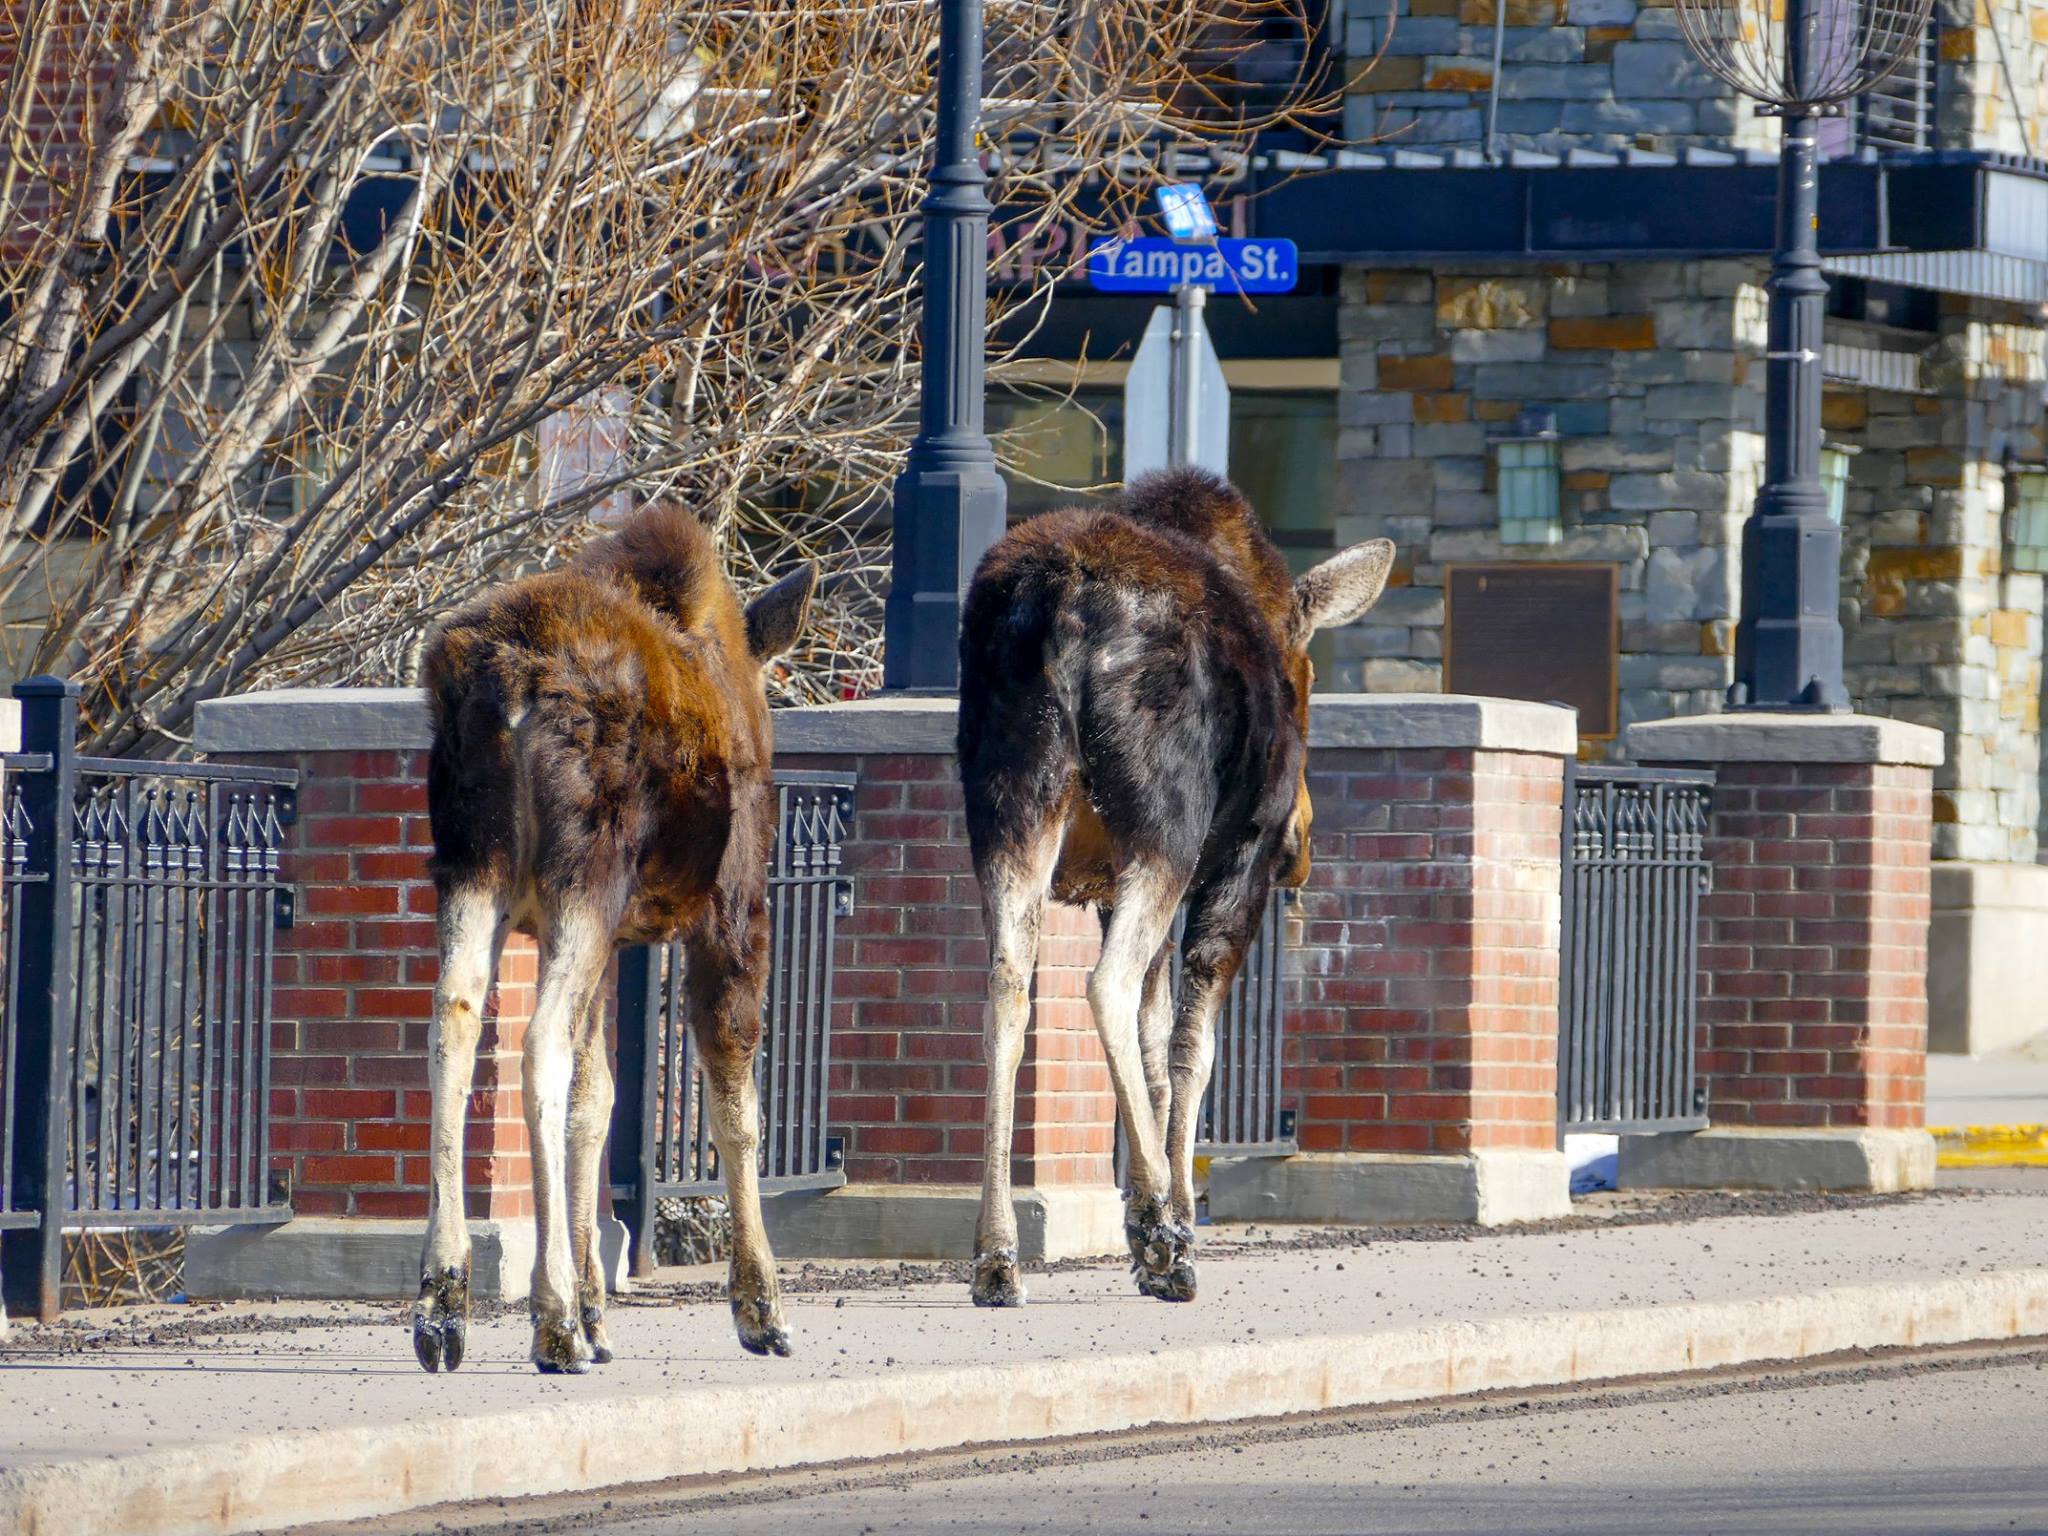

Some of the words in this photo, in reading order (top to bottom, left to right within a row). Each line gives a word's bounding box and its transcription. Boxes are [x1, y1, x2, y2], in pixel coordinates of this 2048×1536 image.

[980, 140, 1248, 184] FFICES
[1102, 243, 1225, 285] Yampa
[1239, 244, 1289, 280] St.
